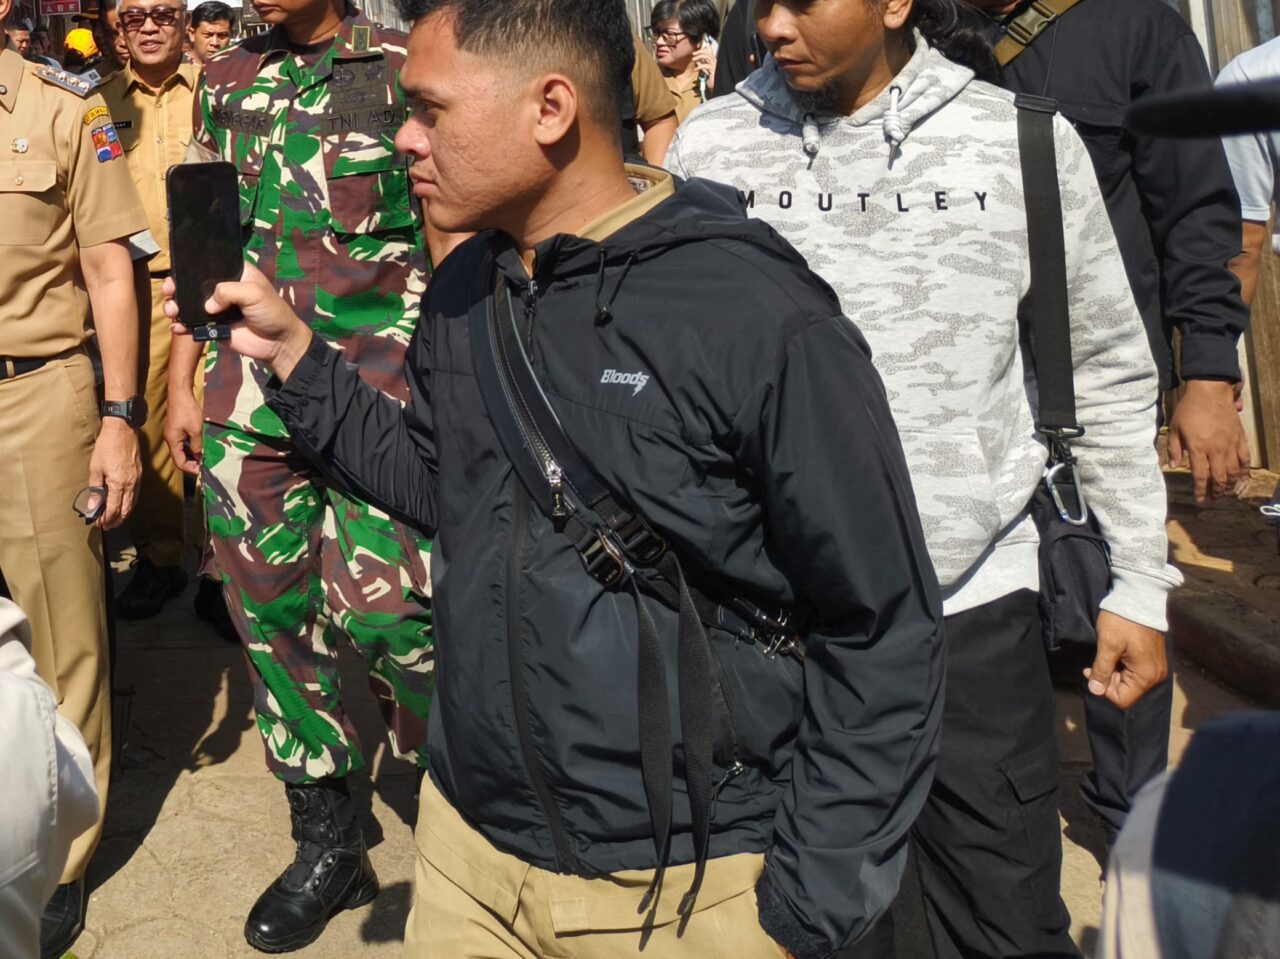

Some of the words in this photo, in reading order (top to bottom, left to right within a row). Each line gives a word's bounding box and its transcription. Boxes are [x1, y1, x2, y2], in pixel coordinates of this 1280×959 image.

[327, 112, 360, 131] TNI
[369, 109, 396, 127] AD
[740, 190, 988, 212] MOUTLEY
[600, 369, 650, 396] Bloods
